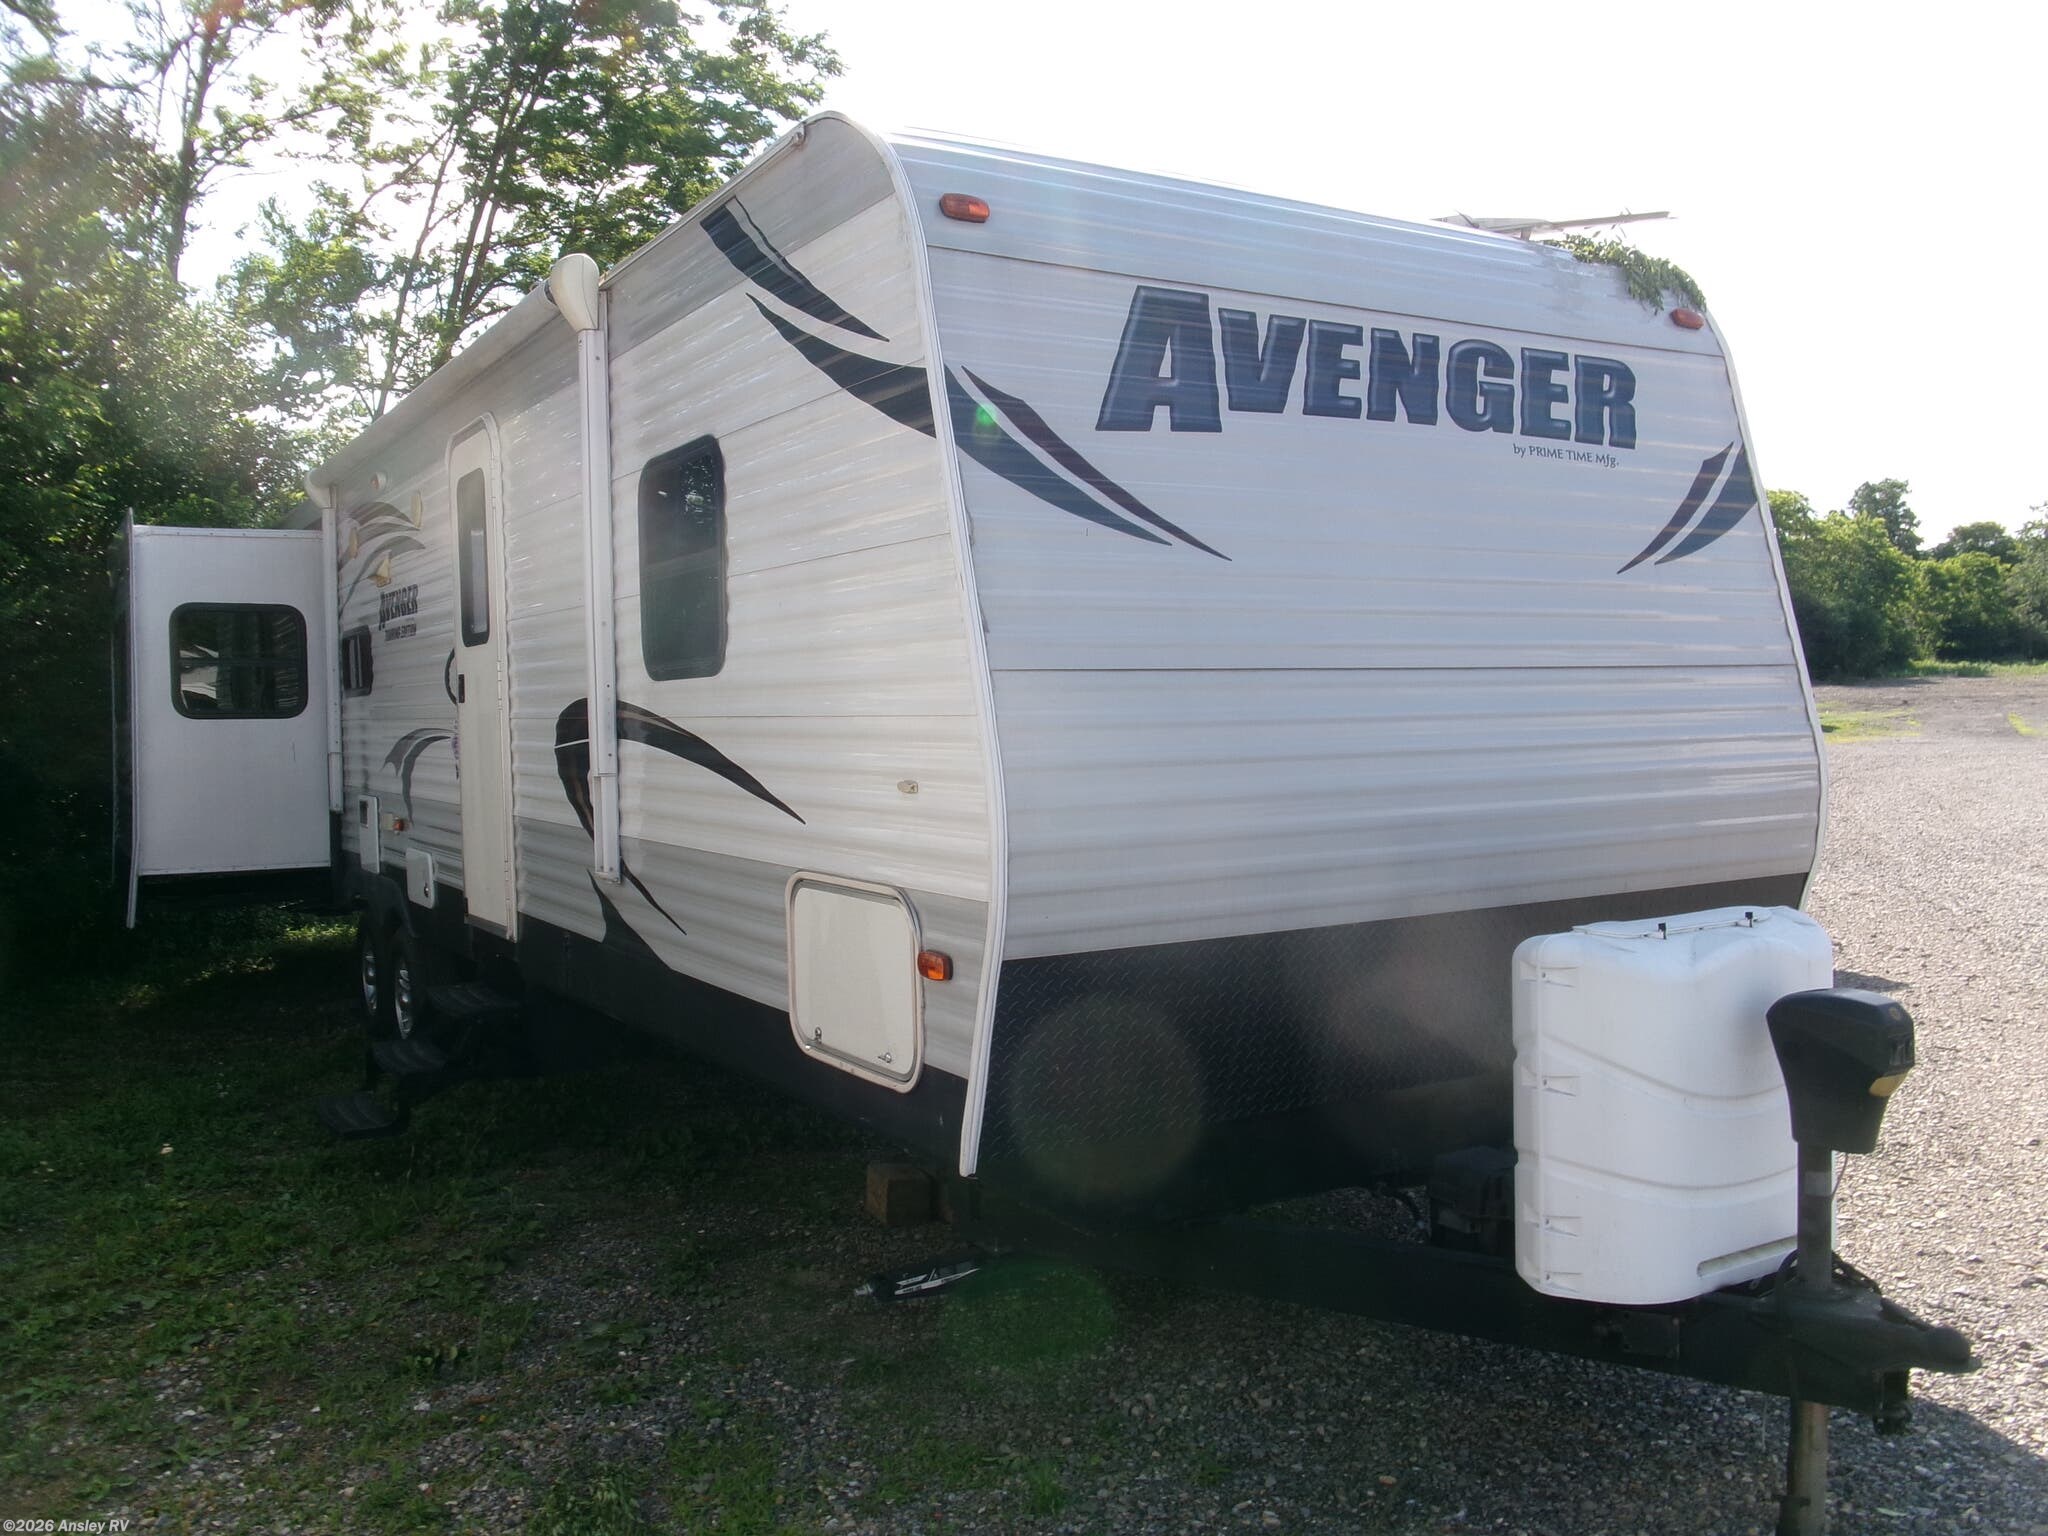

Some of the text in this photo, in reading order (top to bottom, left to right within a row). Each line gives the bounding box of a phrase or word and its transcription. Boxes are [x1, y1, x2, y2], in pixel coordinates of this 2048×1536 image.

[1095, 284, 1637, 449] AVENGER
[1513, 443, 1526, 458] by
[1528, 445, 1564, 460] PRIME
[1565, 449, 1593, 463] TIME
[378, 583, 418, 631] AVENGER
